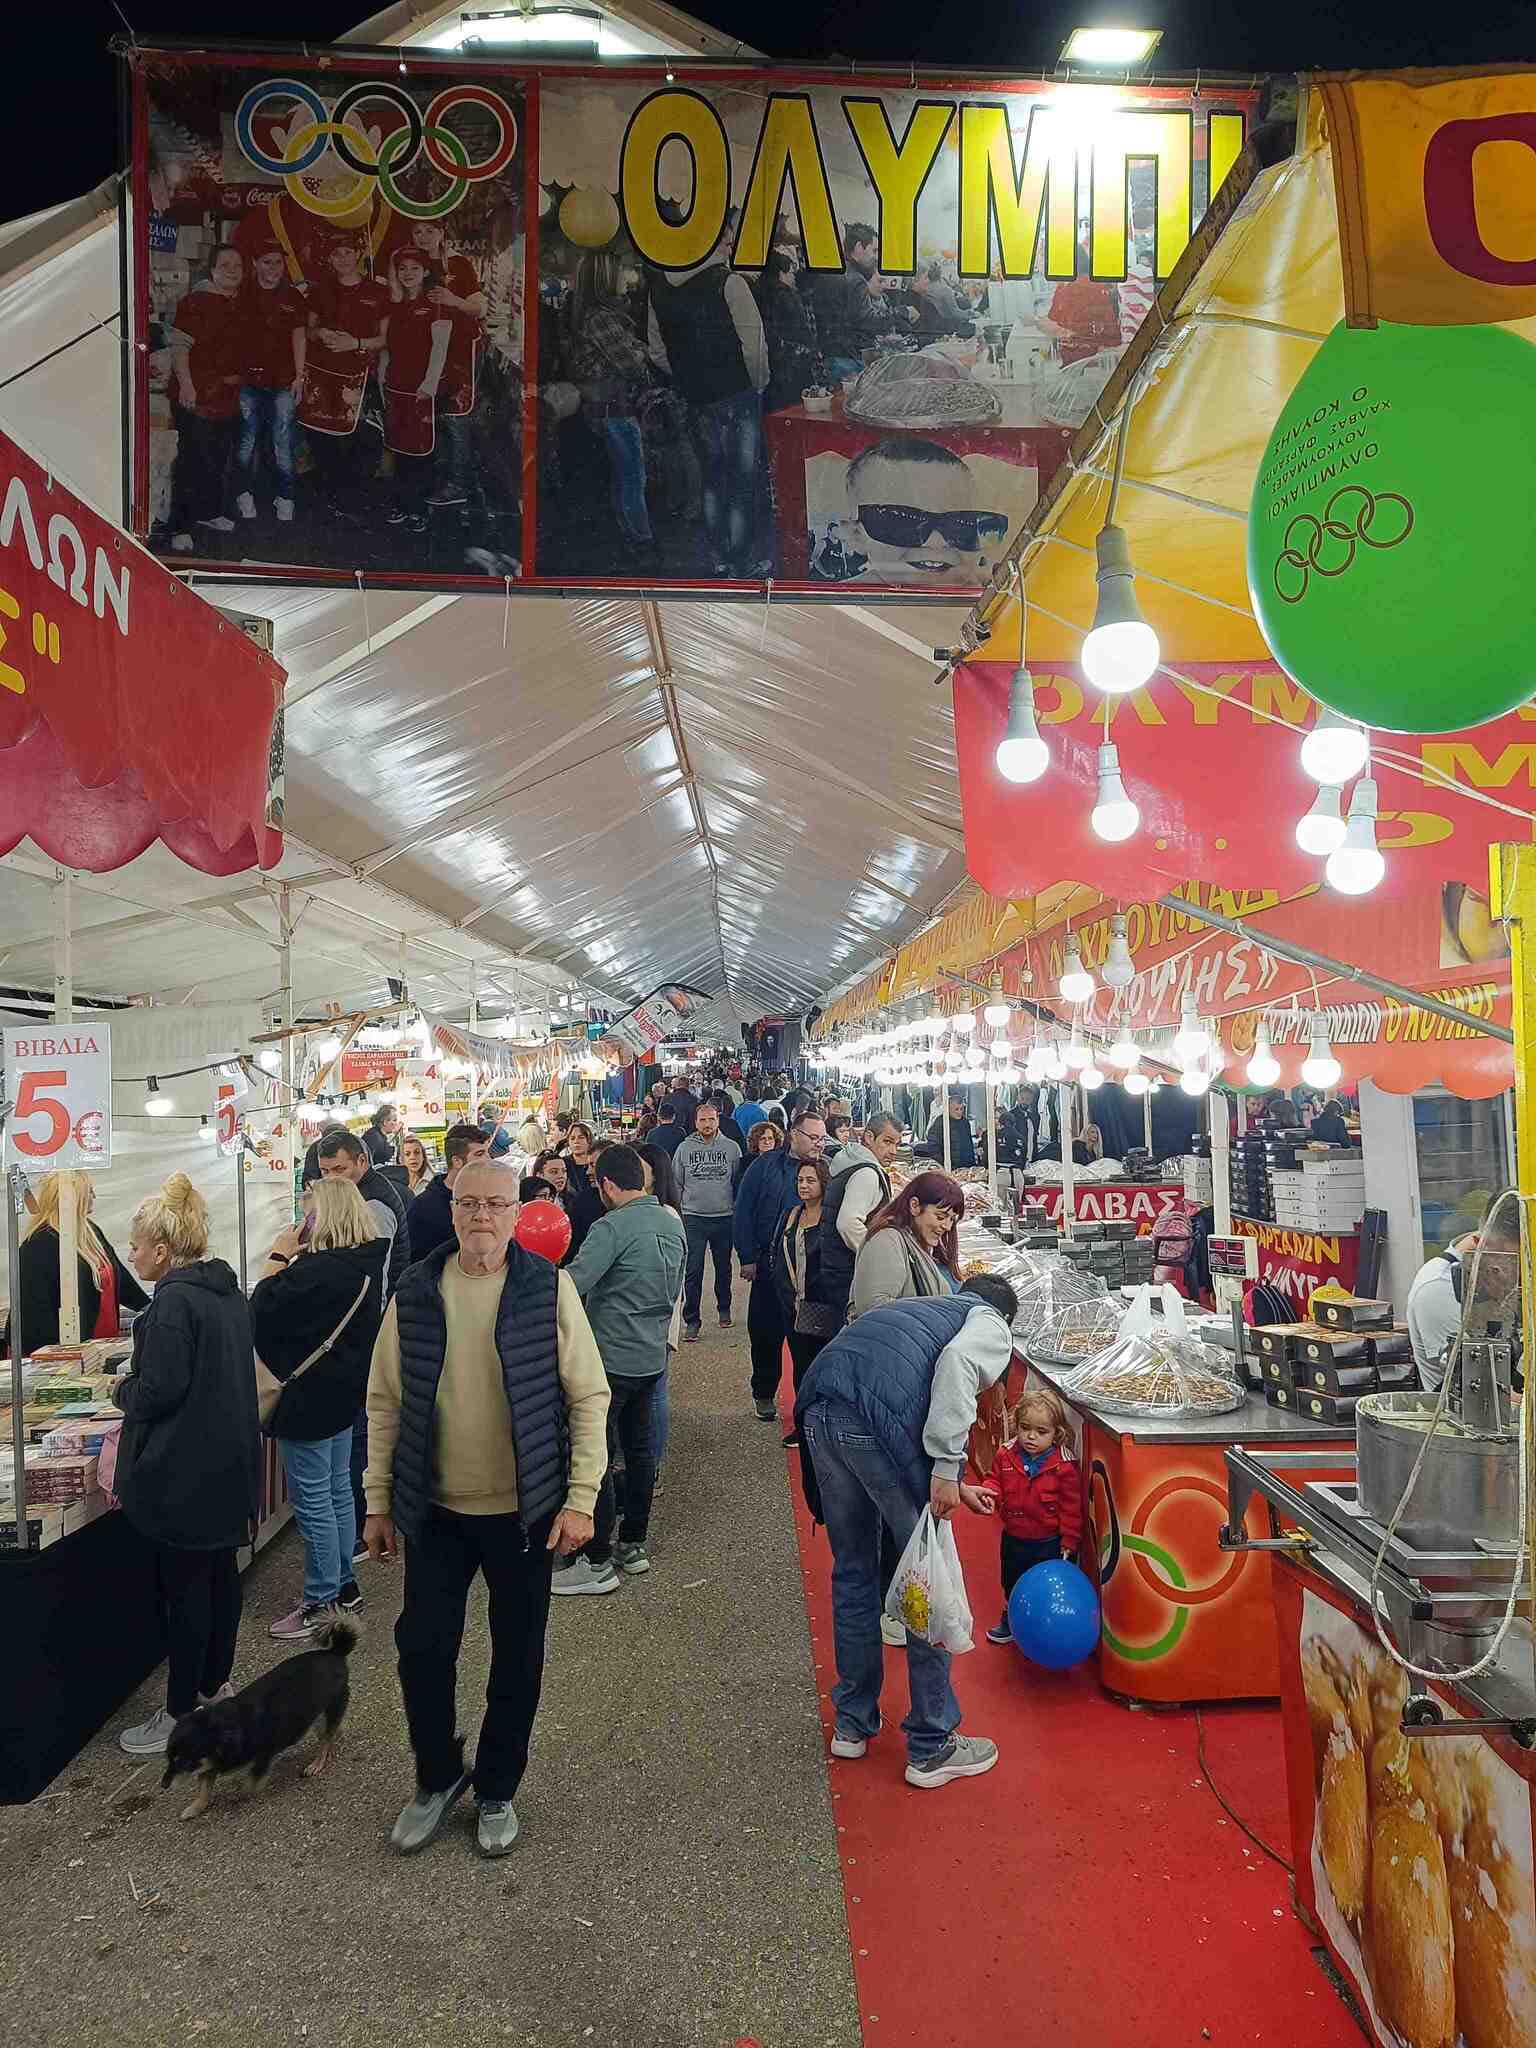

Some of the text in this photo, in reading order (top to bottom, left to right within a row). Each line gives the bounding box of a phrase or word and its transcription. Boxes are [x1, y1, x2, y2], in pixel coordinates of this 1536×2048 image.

[1273, 386, 1368, 456] Ο ΚΟΥΛΗΣ
[1329, 399, 1392, 436] ΧΑΛΒΑΣ
[1268, 443, 1379, 521] ΟΛΥΜΠΙΑΚΟΙ
[1271, 424, 1368, 495] ΛΟΥΚΟΥΜΑΔΕΣ
[14, 1037, 100, 1057] ΒΙΒΛΙΑ
[690, 1151, 728, 1166] NEW YORK
